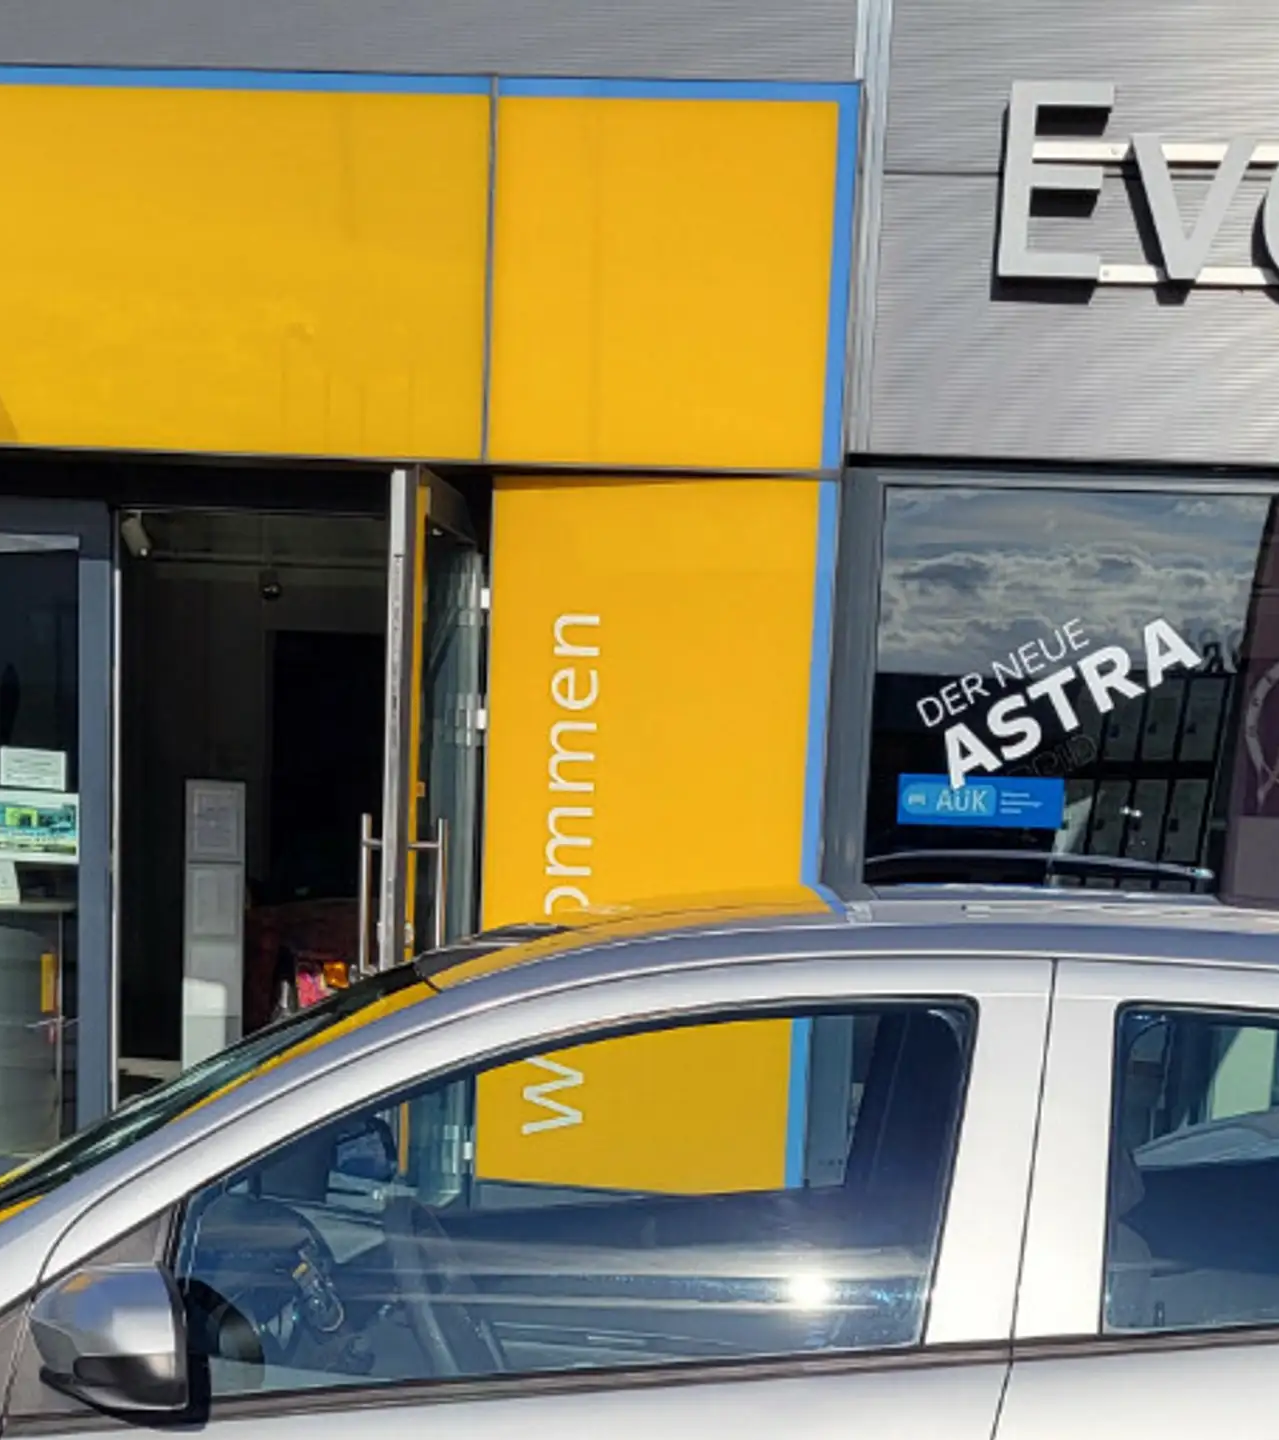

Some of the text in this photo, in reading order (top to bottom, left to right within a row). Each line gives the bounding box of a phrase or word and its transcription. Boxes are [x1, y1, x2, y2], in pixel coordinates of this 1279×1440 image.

[916, 618, 1091, 728] DER NEUE
[943, 618, 1203, 790] ASTRA
